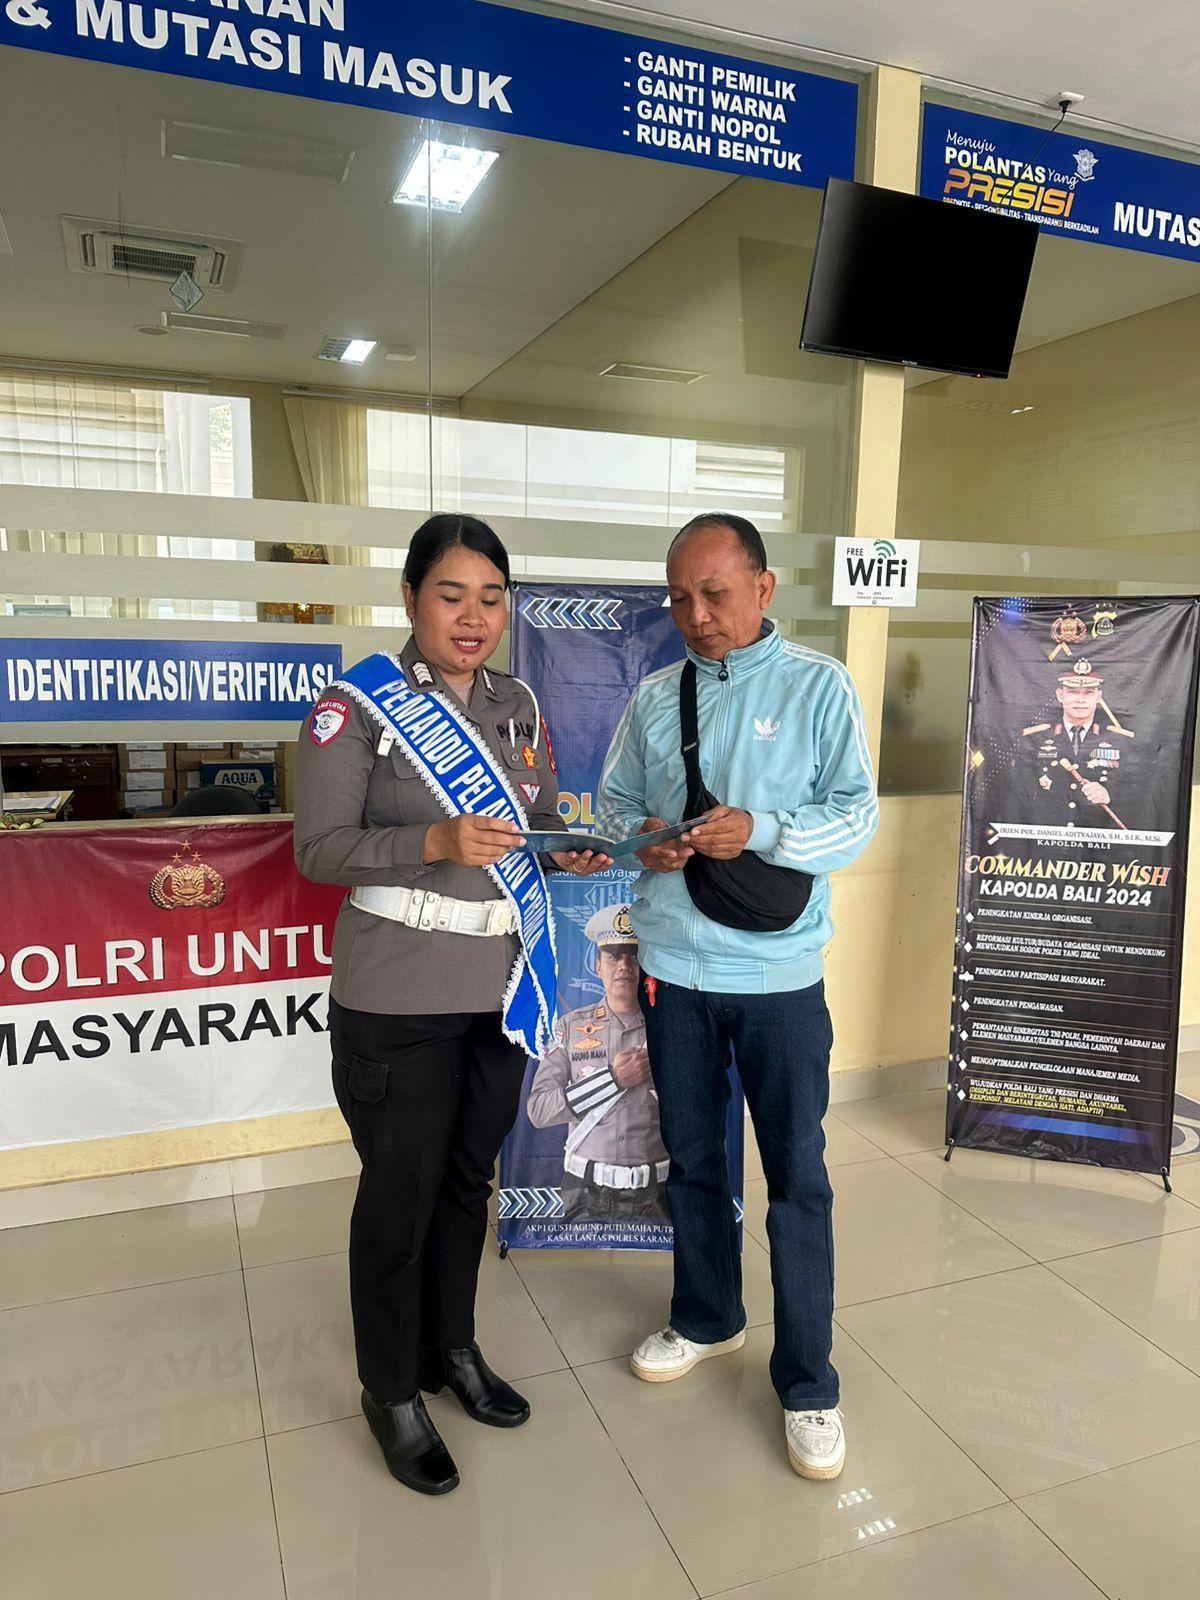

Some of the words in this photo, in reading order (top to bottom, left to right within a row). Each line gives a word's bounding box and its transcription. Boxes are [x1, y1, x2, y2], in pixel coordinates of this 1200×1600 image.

[76, 0, 301, 75] MUTASI
[323, 41, 513, 114] MASUK
[638, 51, 705, 83] GANTI
[712, 66, 796, 102] PEMILIK
[637, 75, 704, 107] GANTI
[711, 90, 787, 123] WARNA
[637, 100, 704, 130] GANTI
[711, 114, 781, 145] NOPOL
[637, 123, 711, 155] RUBAH
[718, 139, 802, 172] BENTUK
[946, 130, 996, 155] Menuju
[945, 146, 1046, 184] POLANTAS
[1048, 167, 1079, 190] Yang
[943, 168, 1075, 218] PRESISI
[846, 547, 864, 556] FREE
[846, 557, 908, 588] WiFi
[371, 679, 474, 776] PEMANDU
[221, 772, 258, 785] AQUA
[1037, 840, 1084, 848] KAPOLDA
[1088, 841, 1111, 850] BALI
[964, 854, 1106, 884] COMMANDER
[1107, 859, 1172, 887] WISH
[979, 879, 1058, 900] KAPOLDA
[1062, 885, 1102, 903] BALI
[1104, 888, 1152, 907] 2024
[977, 908, 1022, 919] PENINGKATAN
[1022, 912, 1051, 921] KINERJA
[975, 942, 1019, 952] MEWUJUDKAN
[1019, 946, 1041, 954] SOSOK
[1041, 948, 1062, 956] POLISI
[1063, 949, 1080, 958] YANG
[976, 934, 1012, 943] REFORMASI
[1063, 941, 1101, 951] ORGANISASI
[1102, 944, 1125, 953] UNTUK
[1125, 946, 1166, 957] MENDUKUNG
[0, 936, 164, 991] OLRI
[974, 967, 1020, 978] PENINGKATAN
[1020, 971, 1060, 982] PARTISIPASI
[973, 996, 1019, 1008] PENINGKATAN
[0, 992, 331, 1066] ASYARAK
[971, 1030, 997, 1039] ELEMEN
[1064, 1040, 1090, 1050] BANGSA
[972, 1022, 1012, 1033] PEMANTAPAN
[1012, 1026, 1049, 1037] SINERGITAS
[1082, 1033, 1124, 1045] PEMERINTAH
[1124, 1038, 1151, 1048] DAERAH
[1151, 1041, 1166, 1050] DAN
[970, 1055, 1028, 1069] MENGOPTIMALKAN
[1028, 1062, 1076, 1074] PENGELOLAAN
[1075, 1067, 1118, 1080] MANAJEMEN
[970, 1079, 1003, 1089] WUJUDKAN
[1003, 1082, 1022, 1091] POLDA
[1023, 1084, 1037, 1092] BALI
[1038, 1086, 1054, 1094] YANG
[1055, 1088, 1079, 1097] PRESISI
[1080, 1092, 1094, 1100] DAN
[996, 1089, 1009, 1097] DAN
[1004, 1096, 1033, 1106] MELAYANI
[1033, 1099, 1059, 1109] DENGAN
[525, 1225, 542, 1233] AKP
[547, 1224, 572, 1232] GUSTI
[573, 1223, 603, 1232] AGUNG
[604, 1224, 626, 1232] PUTU
[627, 1225, 652, 1233] MAHA
[547, 1234, 573, 1242] KASAT
[575, 1234, 607, 1242] LANTAS
[608, 1234, 639, 1242] POLRES
